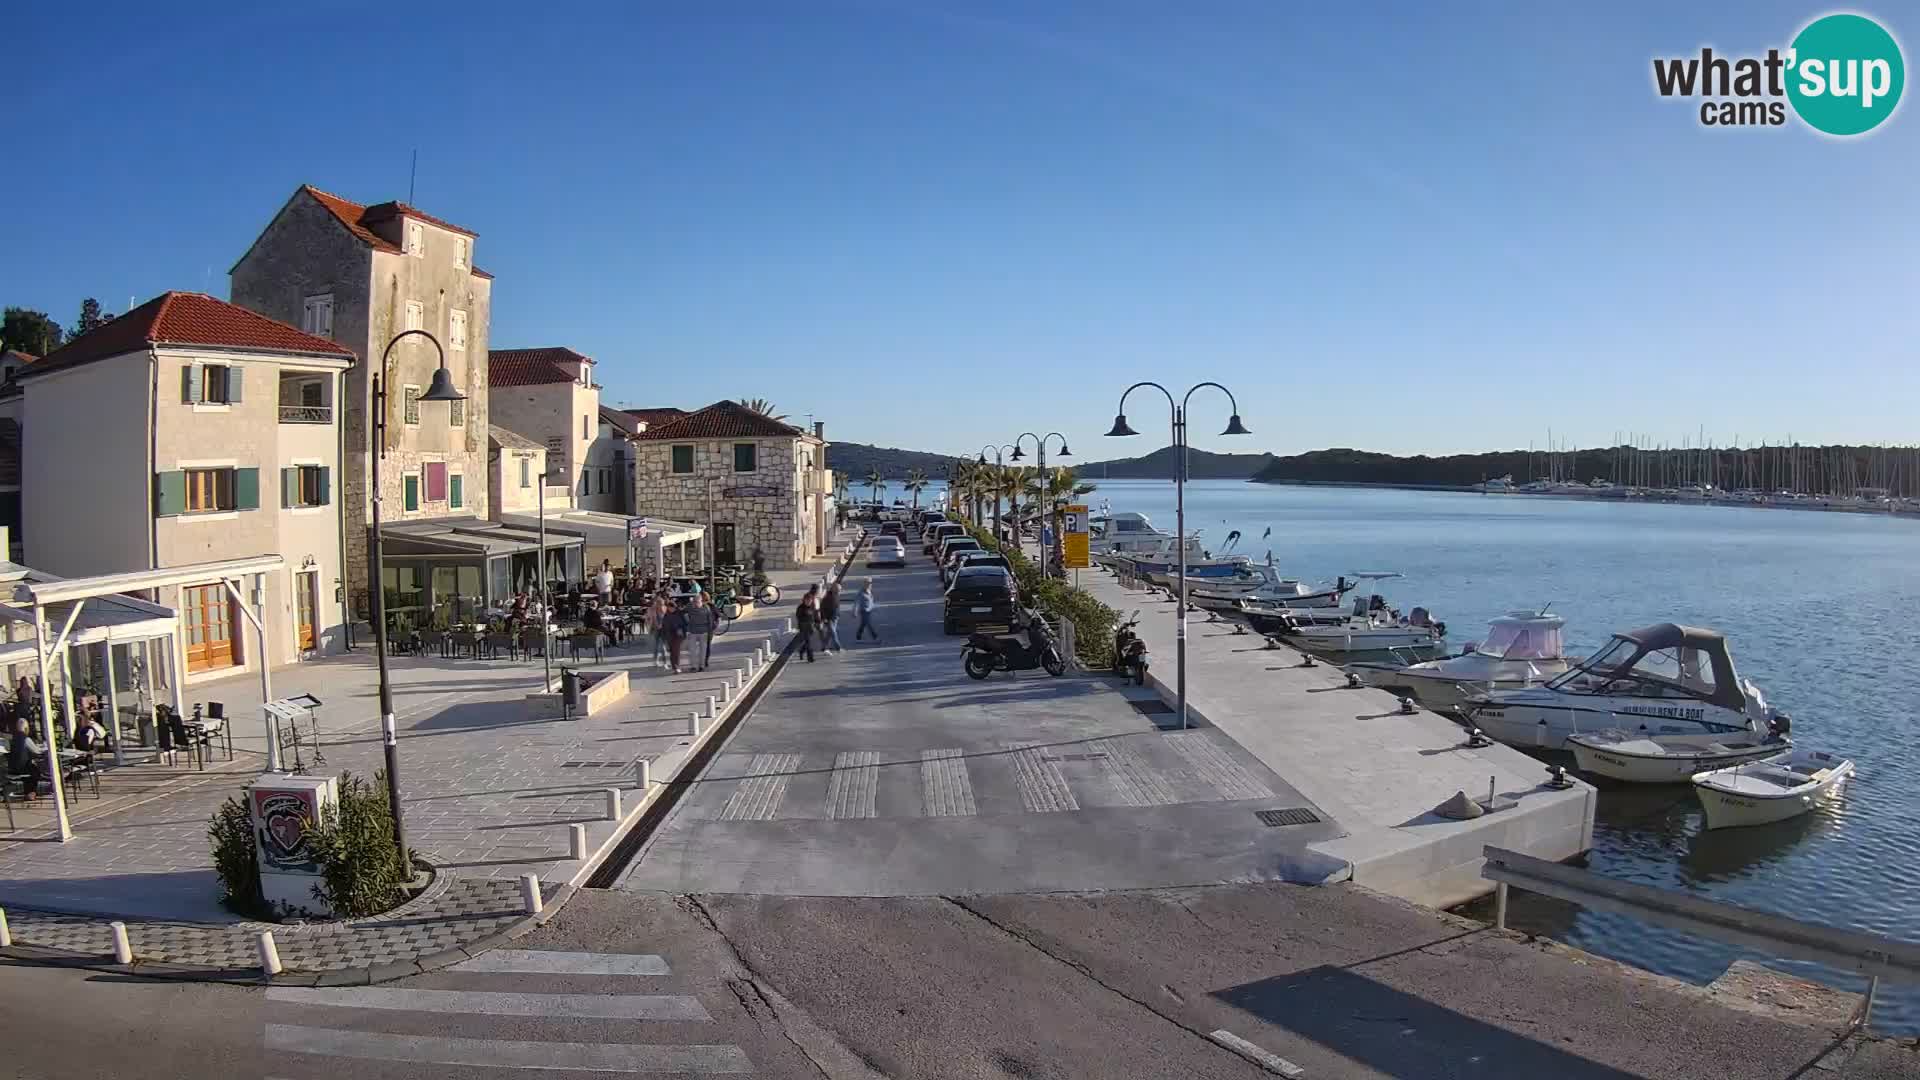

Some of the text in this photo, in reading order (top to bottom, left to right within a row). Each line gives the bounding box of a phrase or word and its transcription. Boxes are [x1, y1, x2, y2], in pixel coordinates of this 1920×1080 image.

[1065, 514, 1076, 531] P
[1657, 706, 1678, 717] RENT
[1685, 708, 1705, 721] BOAT
